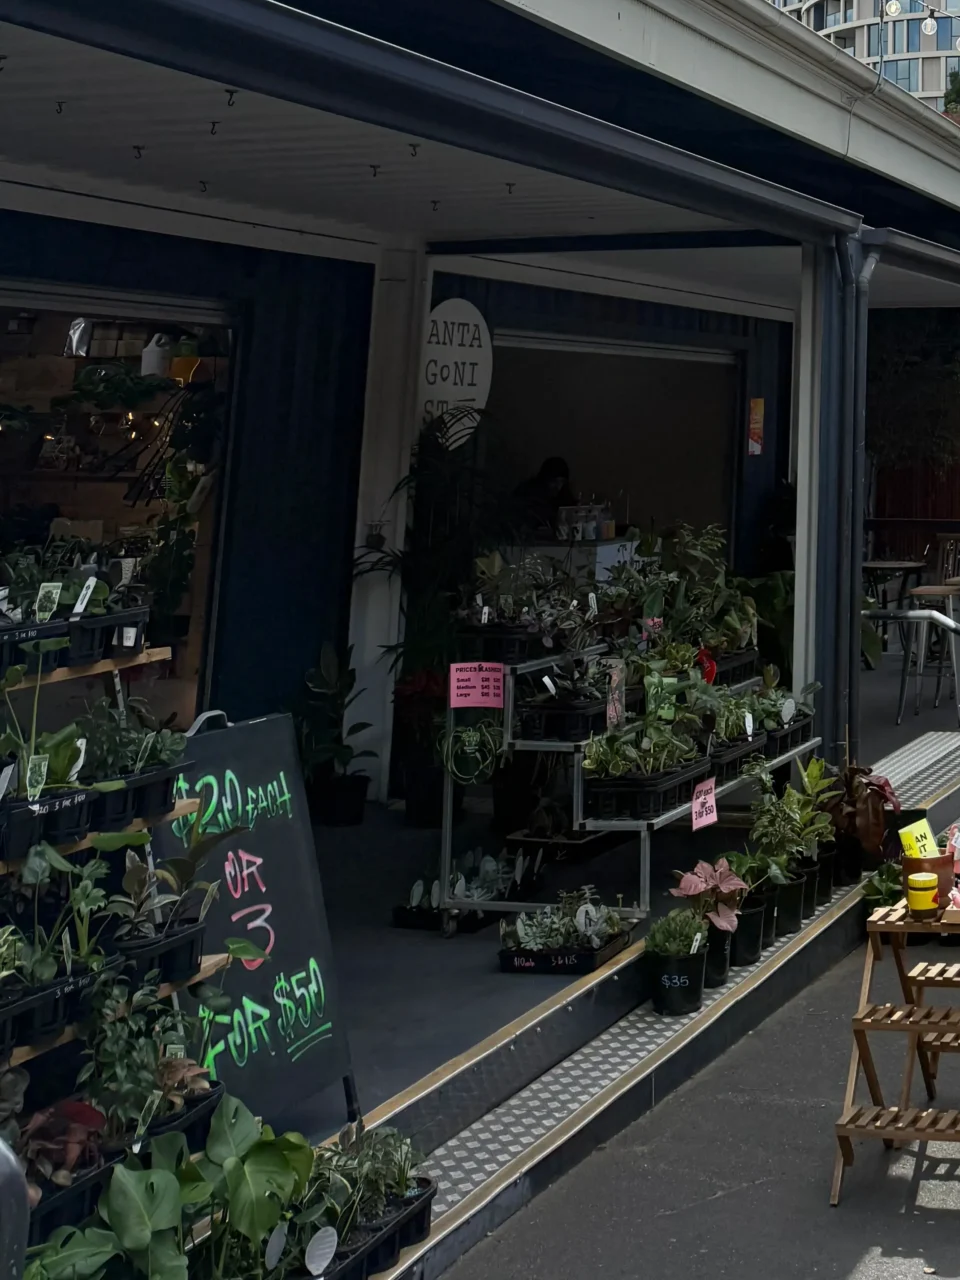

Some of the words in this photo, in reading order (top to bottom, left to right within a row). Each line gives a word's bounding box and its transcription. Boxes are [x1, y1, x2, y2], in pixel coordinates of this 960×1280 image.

[427, 320, 483, 348] ANTA
[246, 771, 292, 831] EACH
[705, 805, 714, 816] $50
[224, 849, 266, 899] OR
[231, 904, 275, 970] 3
[274, 957, 325, 1042] $50
[661, 975, 689, 988] $35
